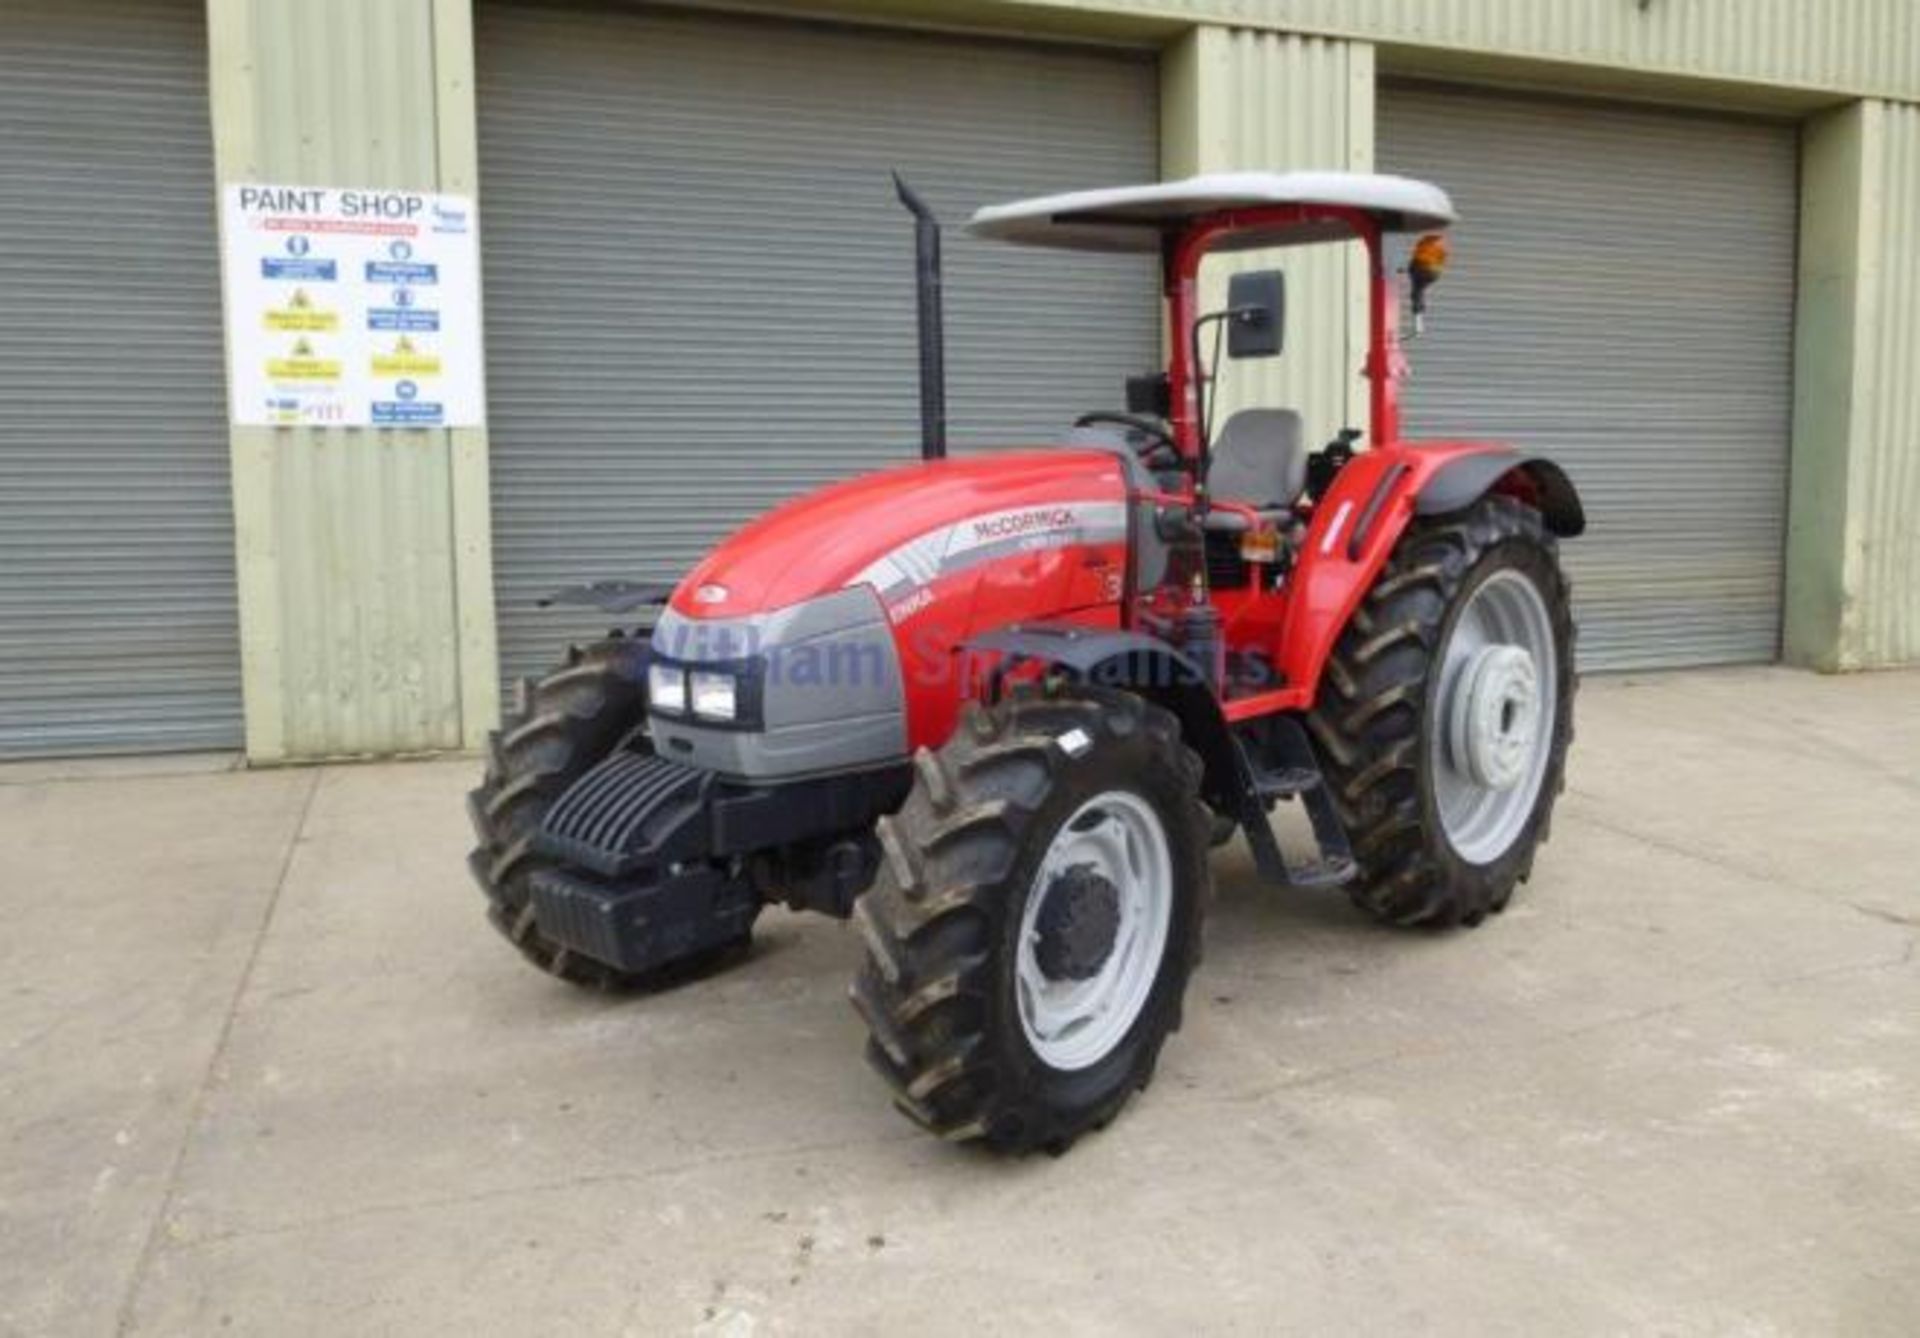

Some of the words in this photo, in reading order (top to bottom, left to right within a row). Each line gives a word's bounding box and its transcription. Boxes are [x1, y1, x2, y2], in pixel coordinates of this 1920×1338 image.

[240, 188, 325, 213] PAINT
[340, 192, 423, 217] SHOP
[974, 509, 1074, 540] McCORMICK
